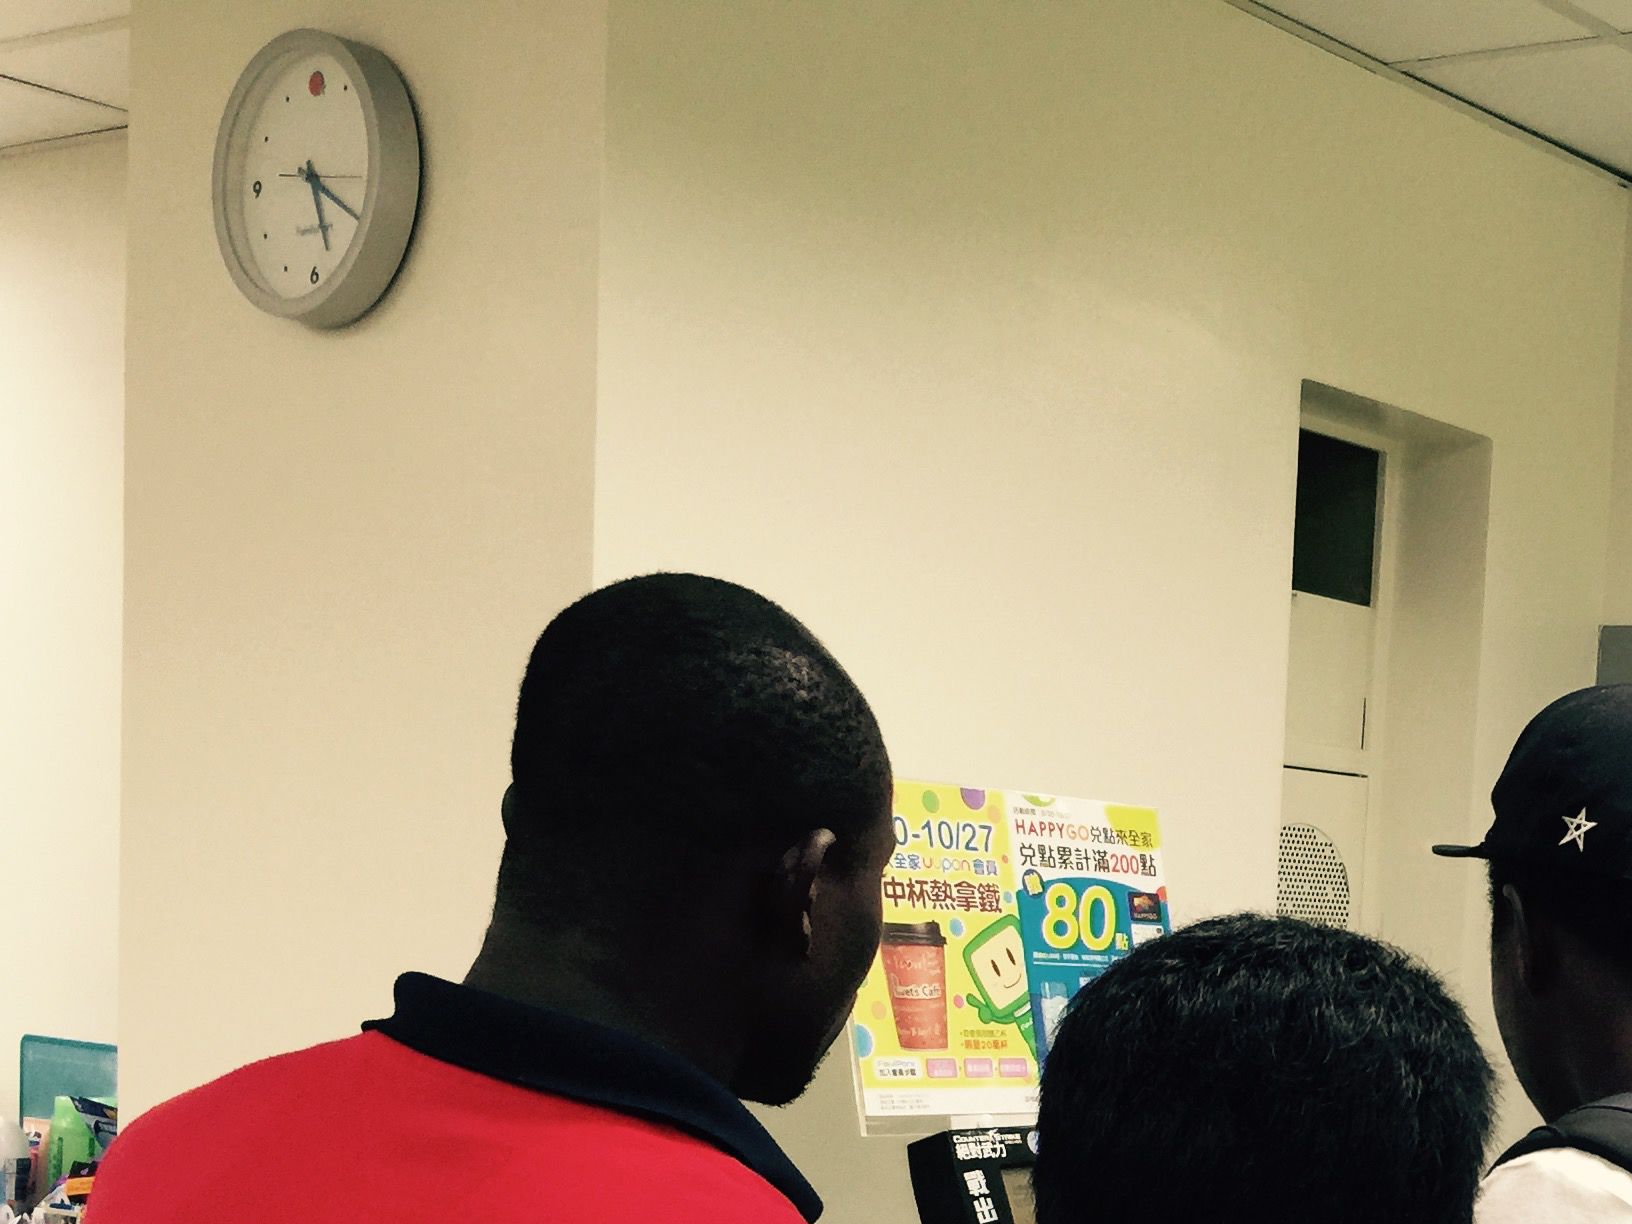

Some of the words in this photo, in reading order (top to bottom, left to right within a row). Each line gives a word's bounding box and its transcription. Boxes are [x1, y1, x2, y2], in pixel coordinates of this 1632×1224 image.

[252, 180, 262, 198] 9
[310, 266, 319, 284] 6
[883, 876, 1002, 913] 中杯熱拿鐵
